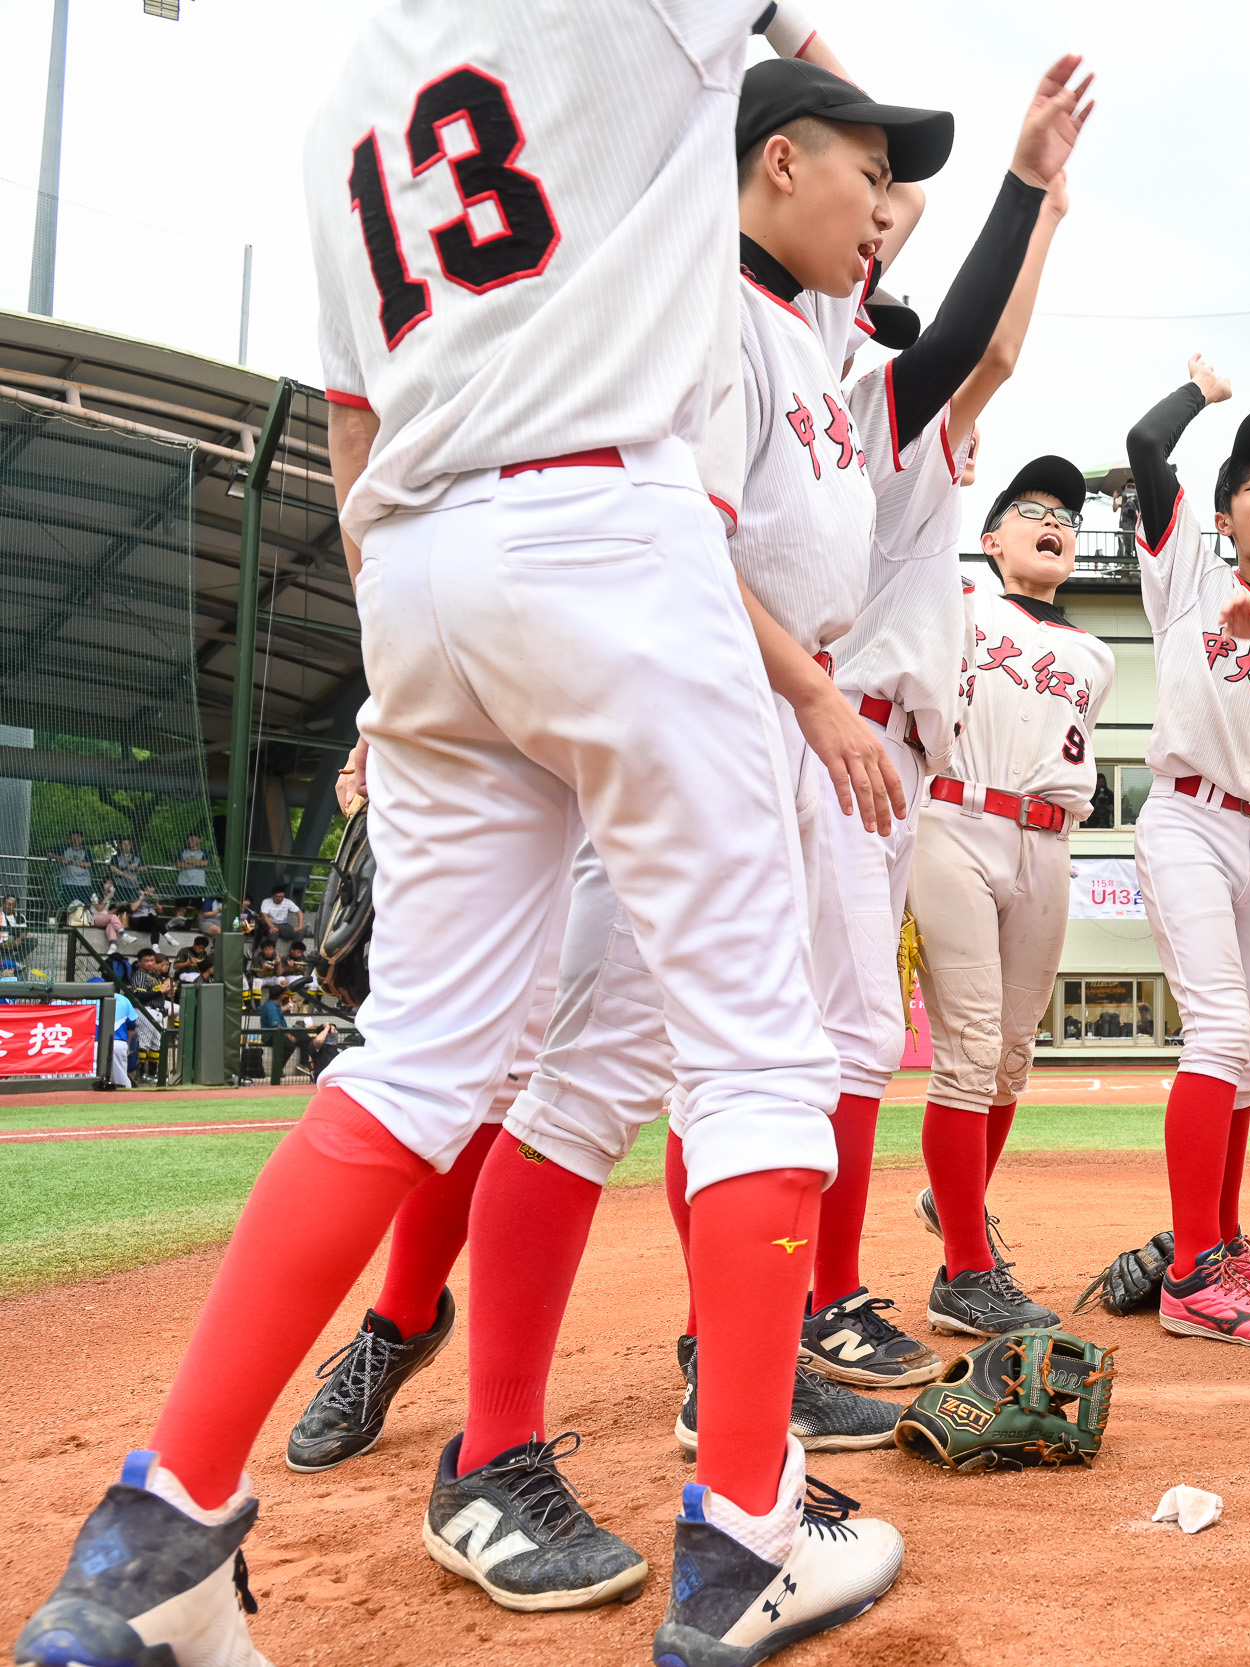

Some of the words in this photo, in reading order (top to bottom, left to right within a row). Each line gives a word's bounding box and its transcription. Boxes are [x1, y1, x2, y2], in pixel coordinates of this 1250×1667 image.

[347, 62, 562, 353] 13
[1062, 724, 1086, 765] 9
[942, 1397, 991, 1428] ZETT
